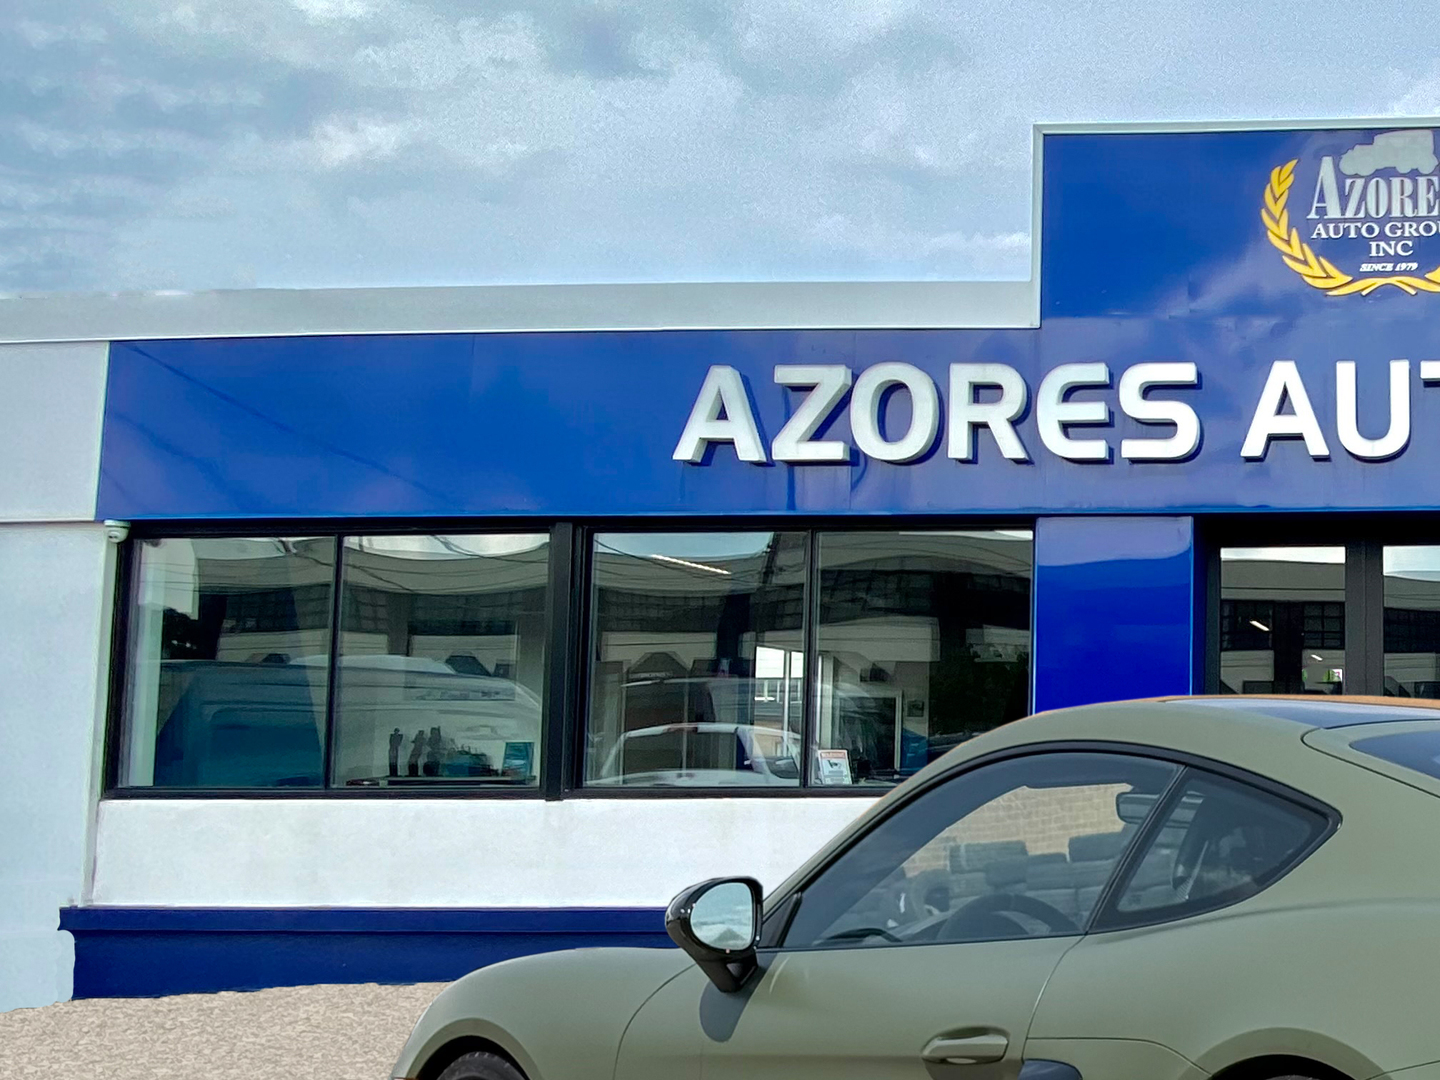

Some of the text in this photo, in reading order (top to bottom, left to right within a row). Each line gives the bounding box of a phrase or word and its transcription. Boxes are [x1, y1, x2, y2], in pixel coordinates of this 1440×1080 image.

[1311, 222, 1379, 240] AUTO
[1368, 240, 1414, 257] INC
[1359, 262, 1418, 272] SINCE 1979
[672, 361, 1202, 465] AZORES
